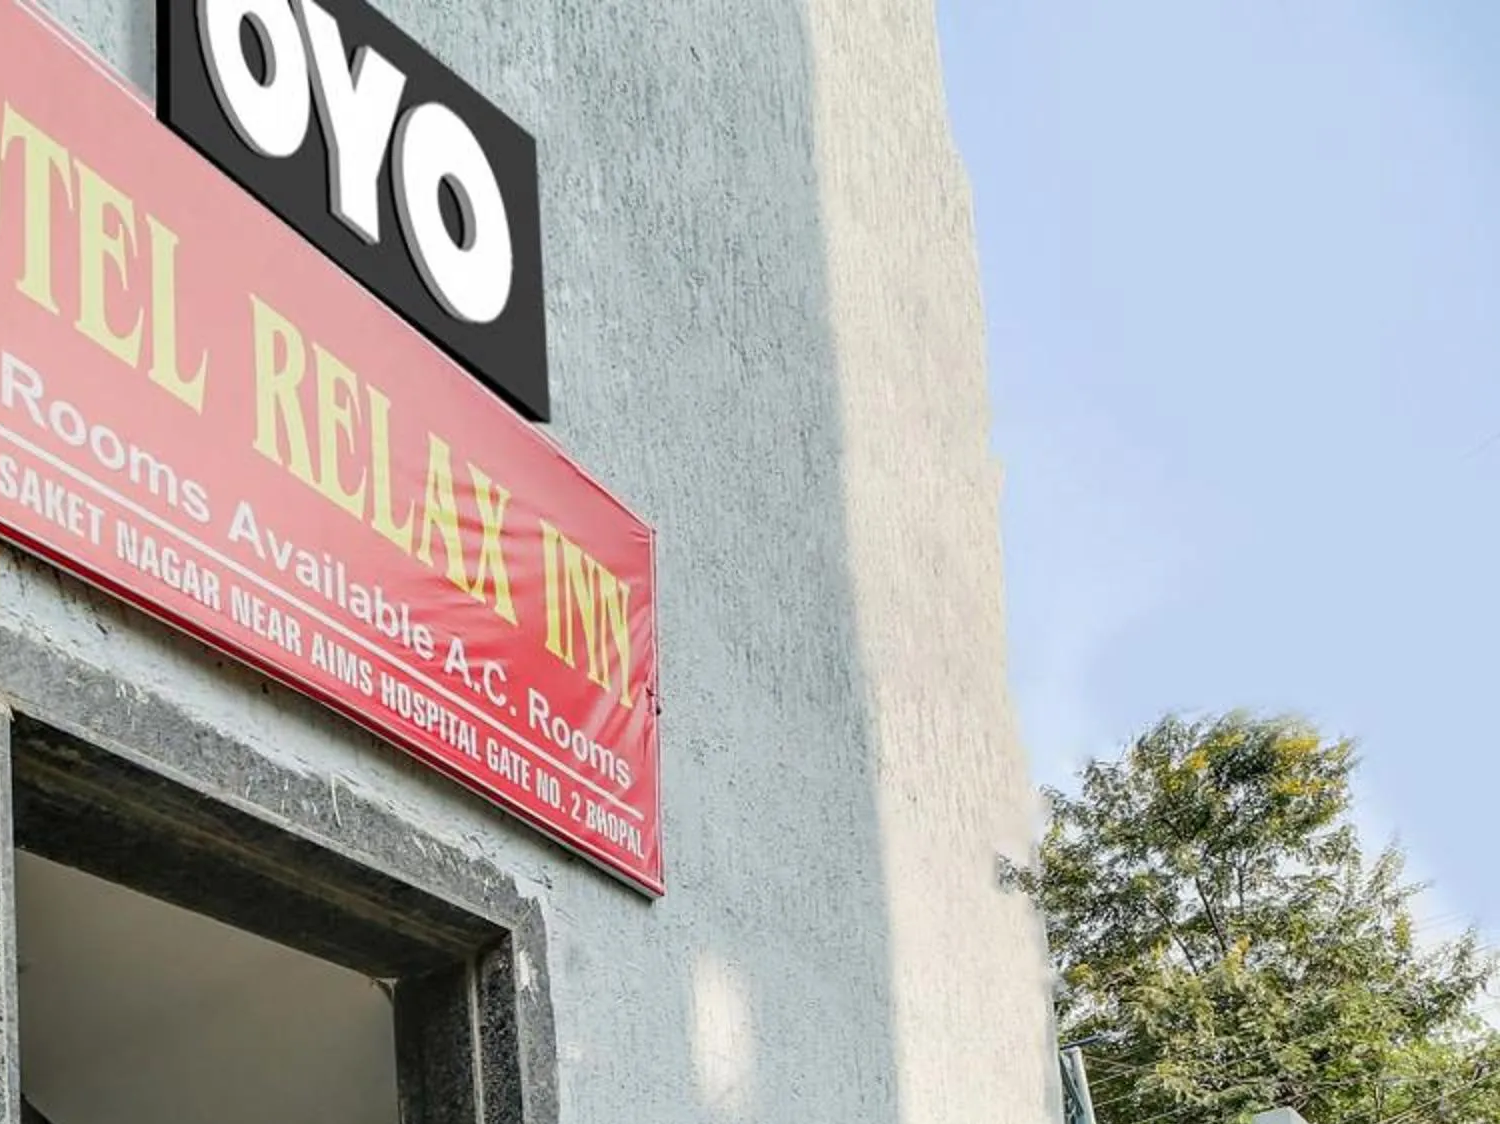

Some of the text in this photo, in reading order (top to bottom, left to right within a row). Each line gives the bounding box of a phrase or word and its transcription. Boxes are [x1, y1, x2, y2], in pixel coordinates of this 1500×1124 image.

[197, 0, 513, 324] OYO
[0, 350, 211, 524] Rooms
[227, 500, 435, 661] Available
[443, 637, 518, 717] A.C.
[527, 687, 633, 789] Rooms
[251, 293, 519, 626] RELAX
[539, 518, 634, 709] INN
[116, 520, 222, 611] NAGAR
[231, 584, 303, 658] NEAR
[311, 629, 374, 697] AIMS
[381, 671, 482, 759] HOSPITAL
[486, 742, 531, 789] GATE
[535, 770, 567, 813] NO.
[571, 791, 582, 823] 2
[585, 797, 646, 861] BHOPAL
